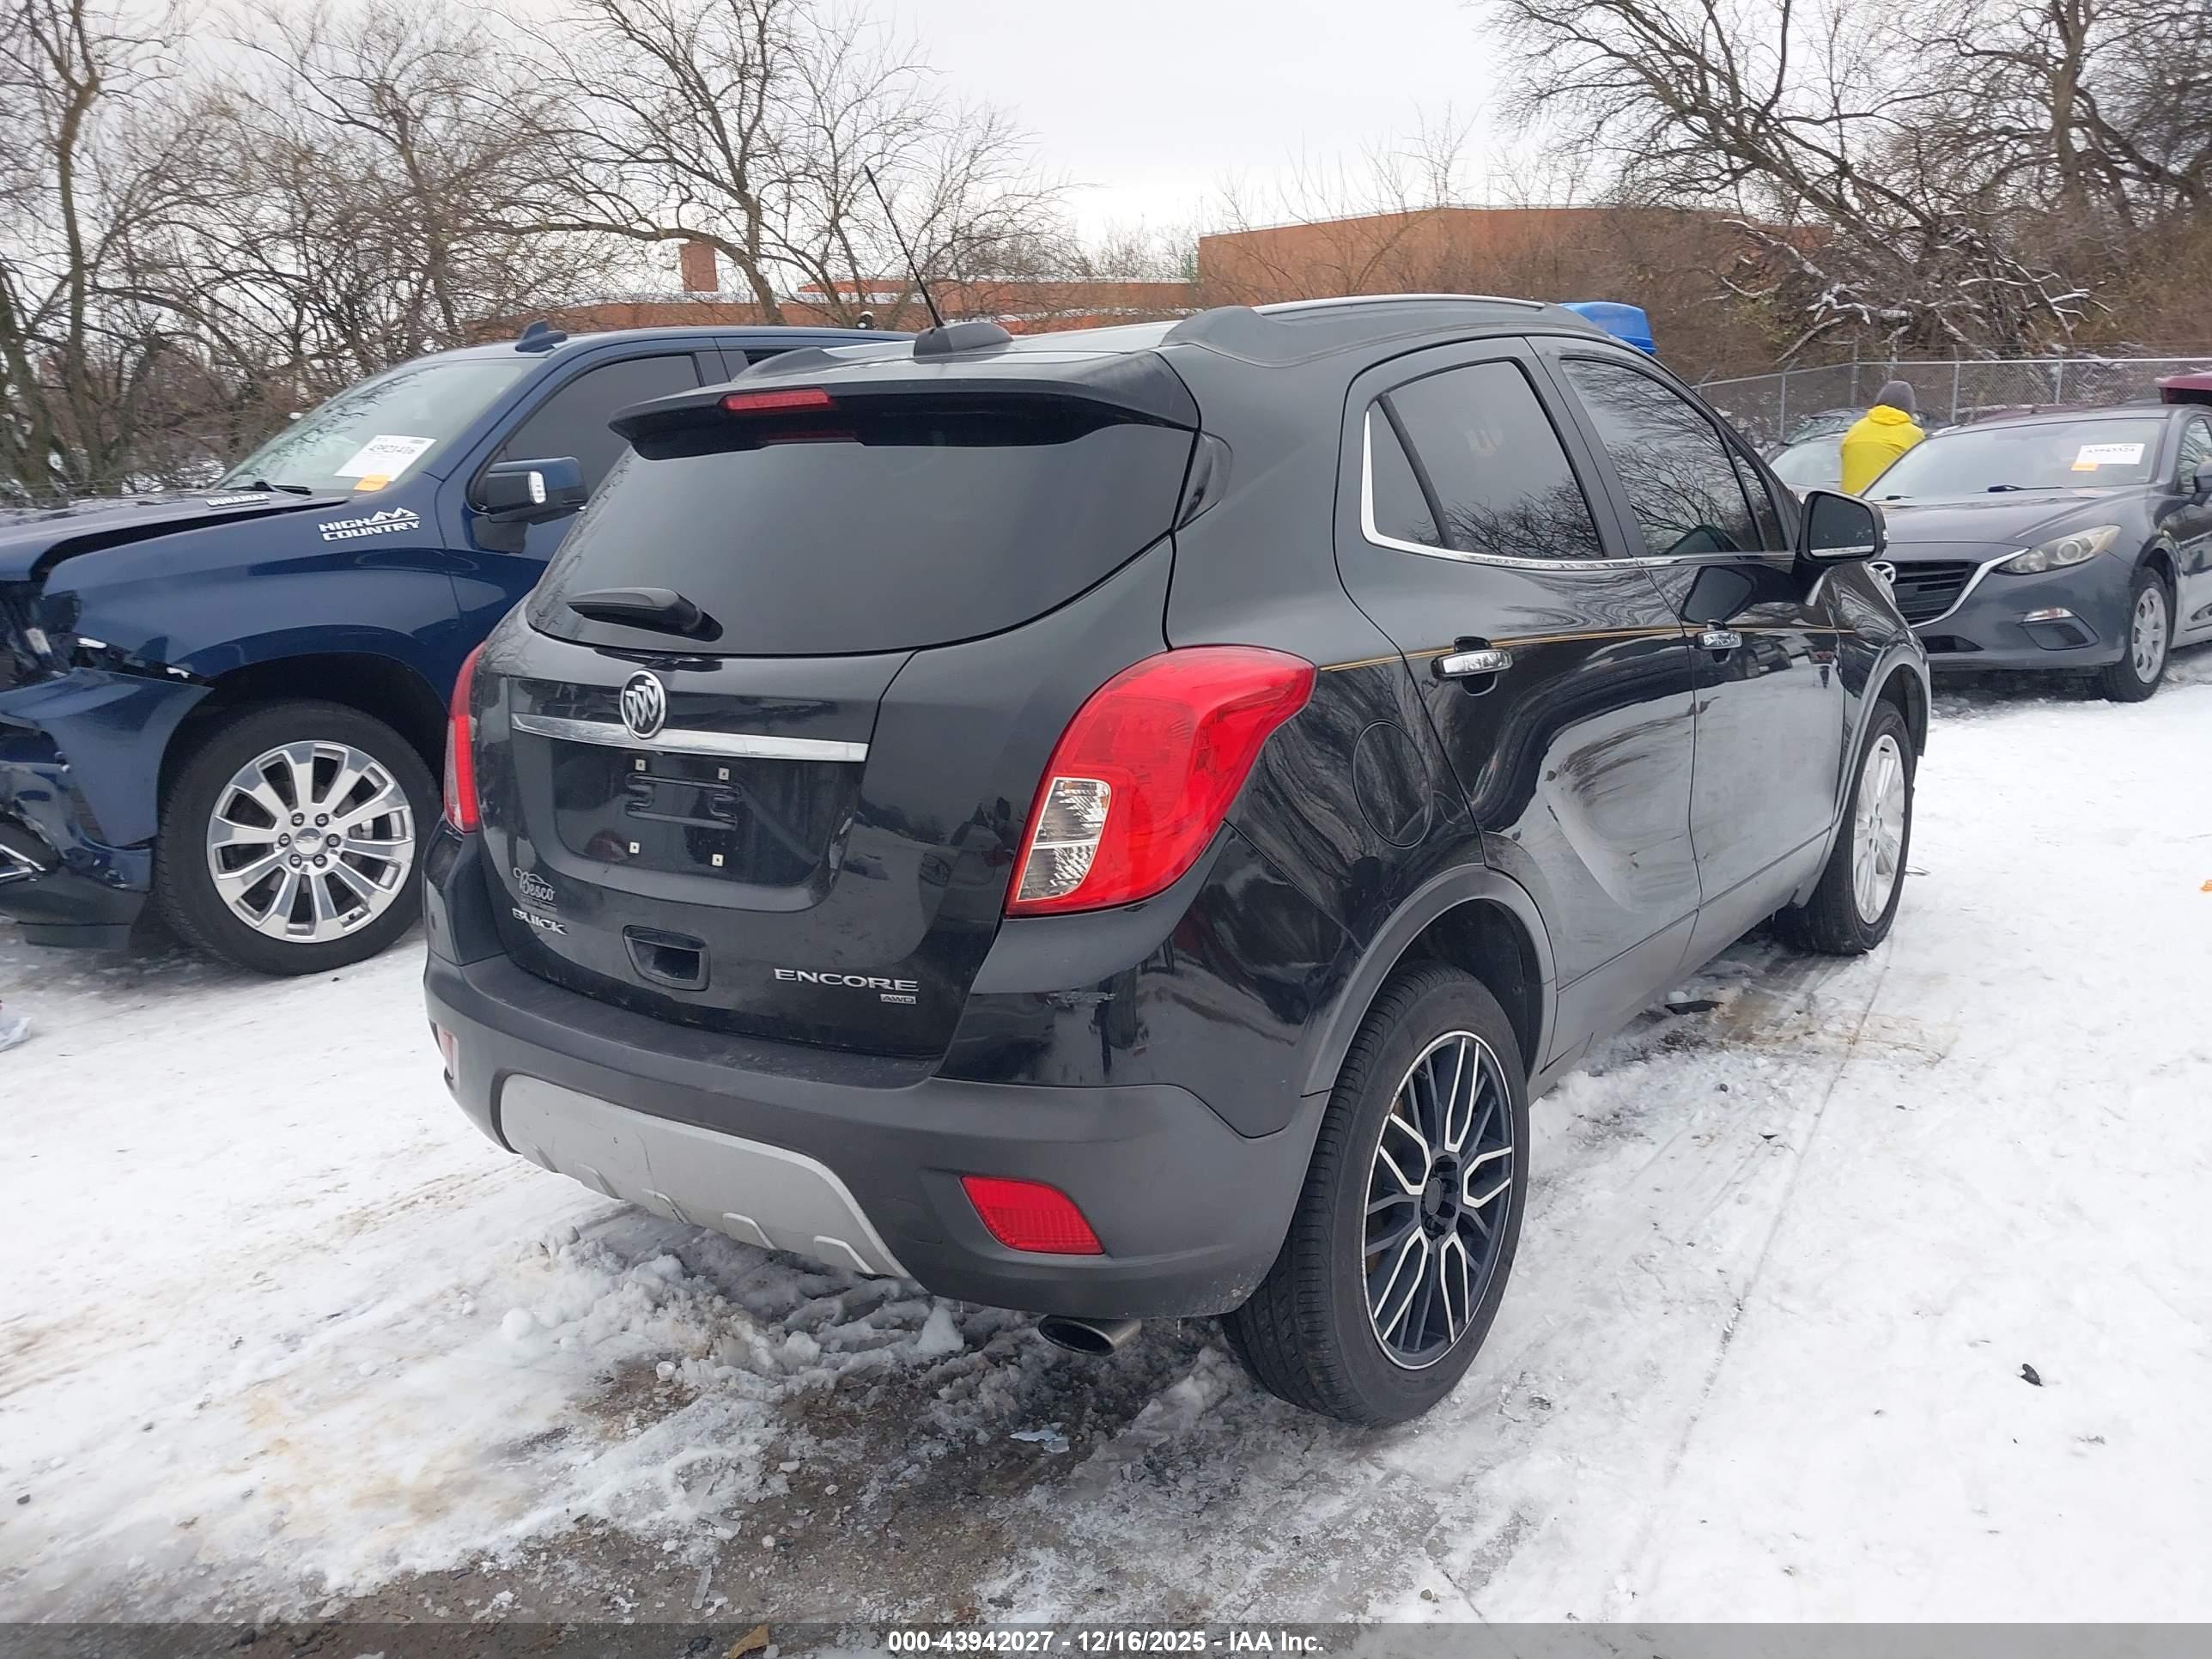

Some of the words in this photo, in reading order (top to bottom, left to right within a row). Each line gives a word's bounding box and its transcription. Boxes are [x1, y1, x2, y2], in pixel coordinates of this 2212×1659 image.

[318, 517, 371, 532] HIGH
[322, 520, 420, 542] COUNTRY
[513, 867, 556, 901] Besco
[512, 908, 568, 936] BUICK
[774, 968, 920, 993] ENCORE
[881, 994, 915, 1004] AWD
